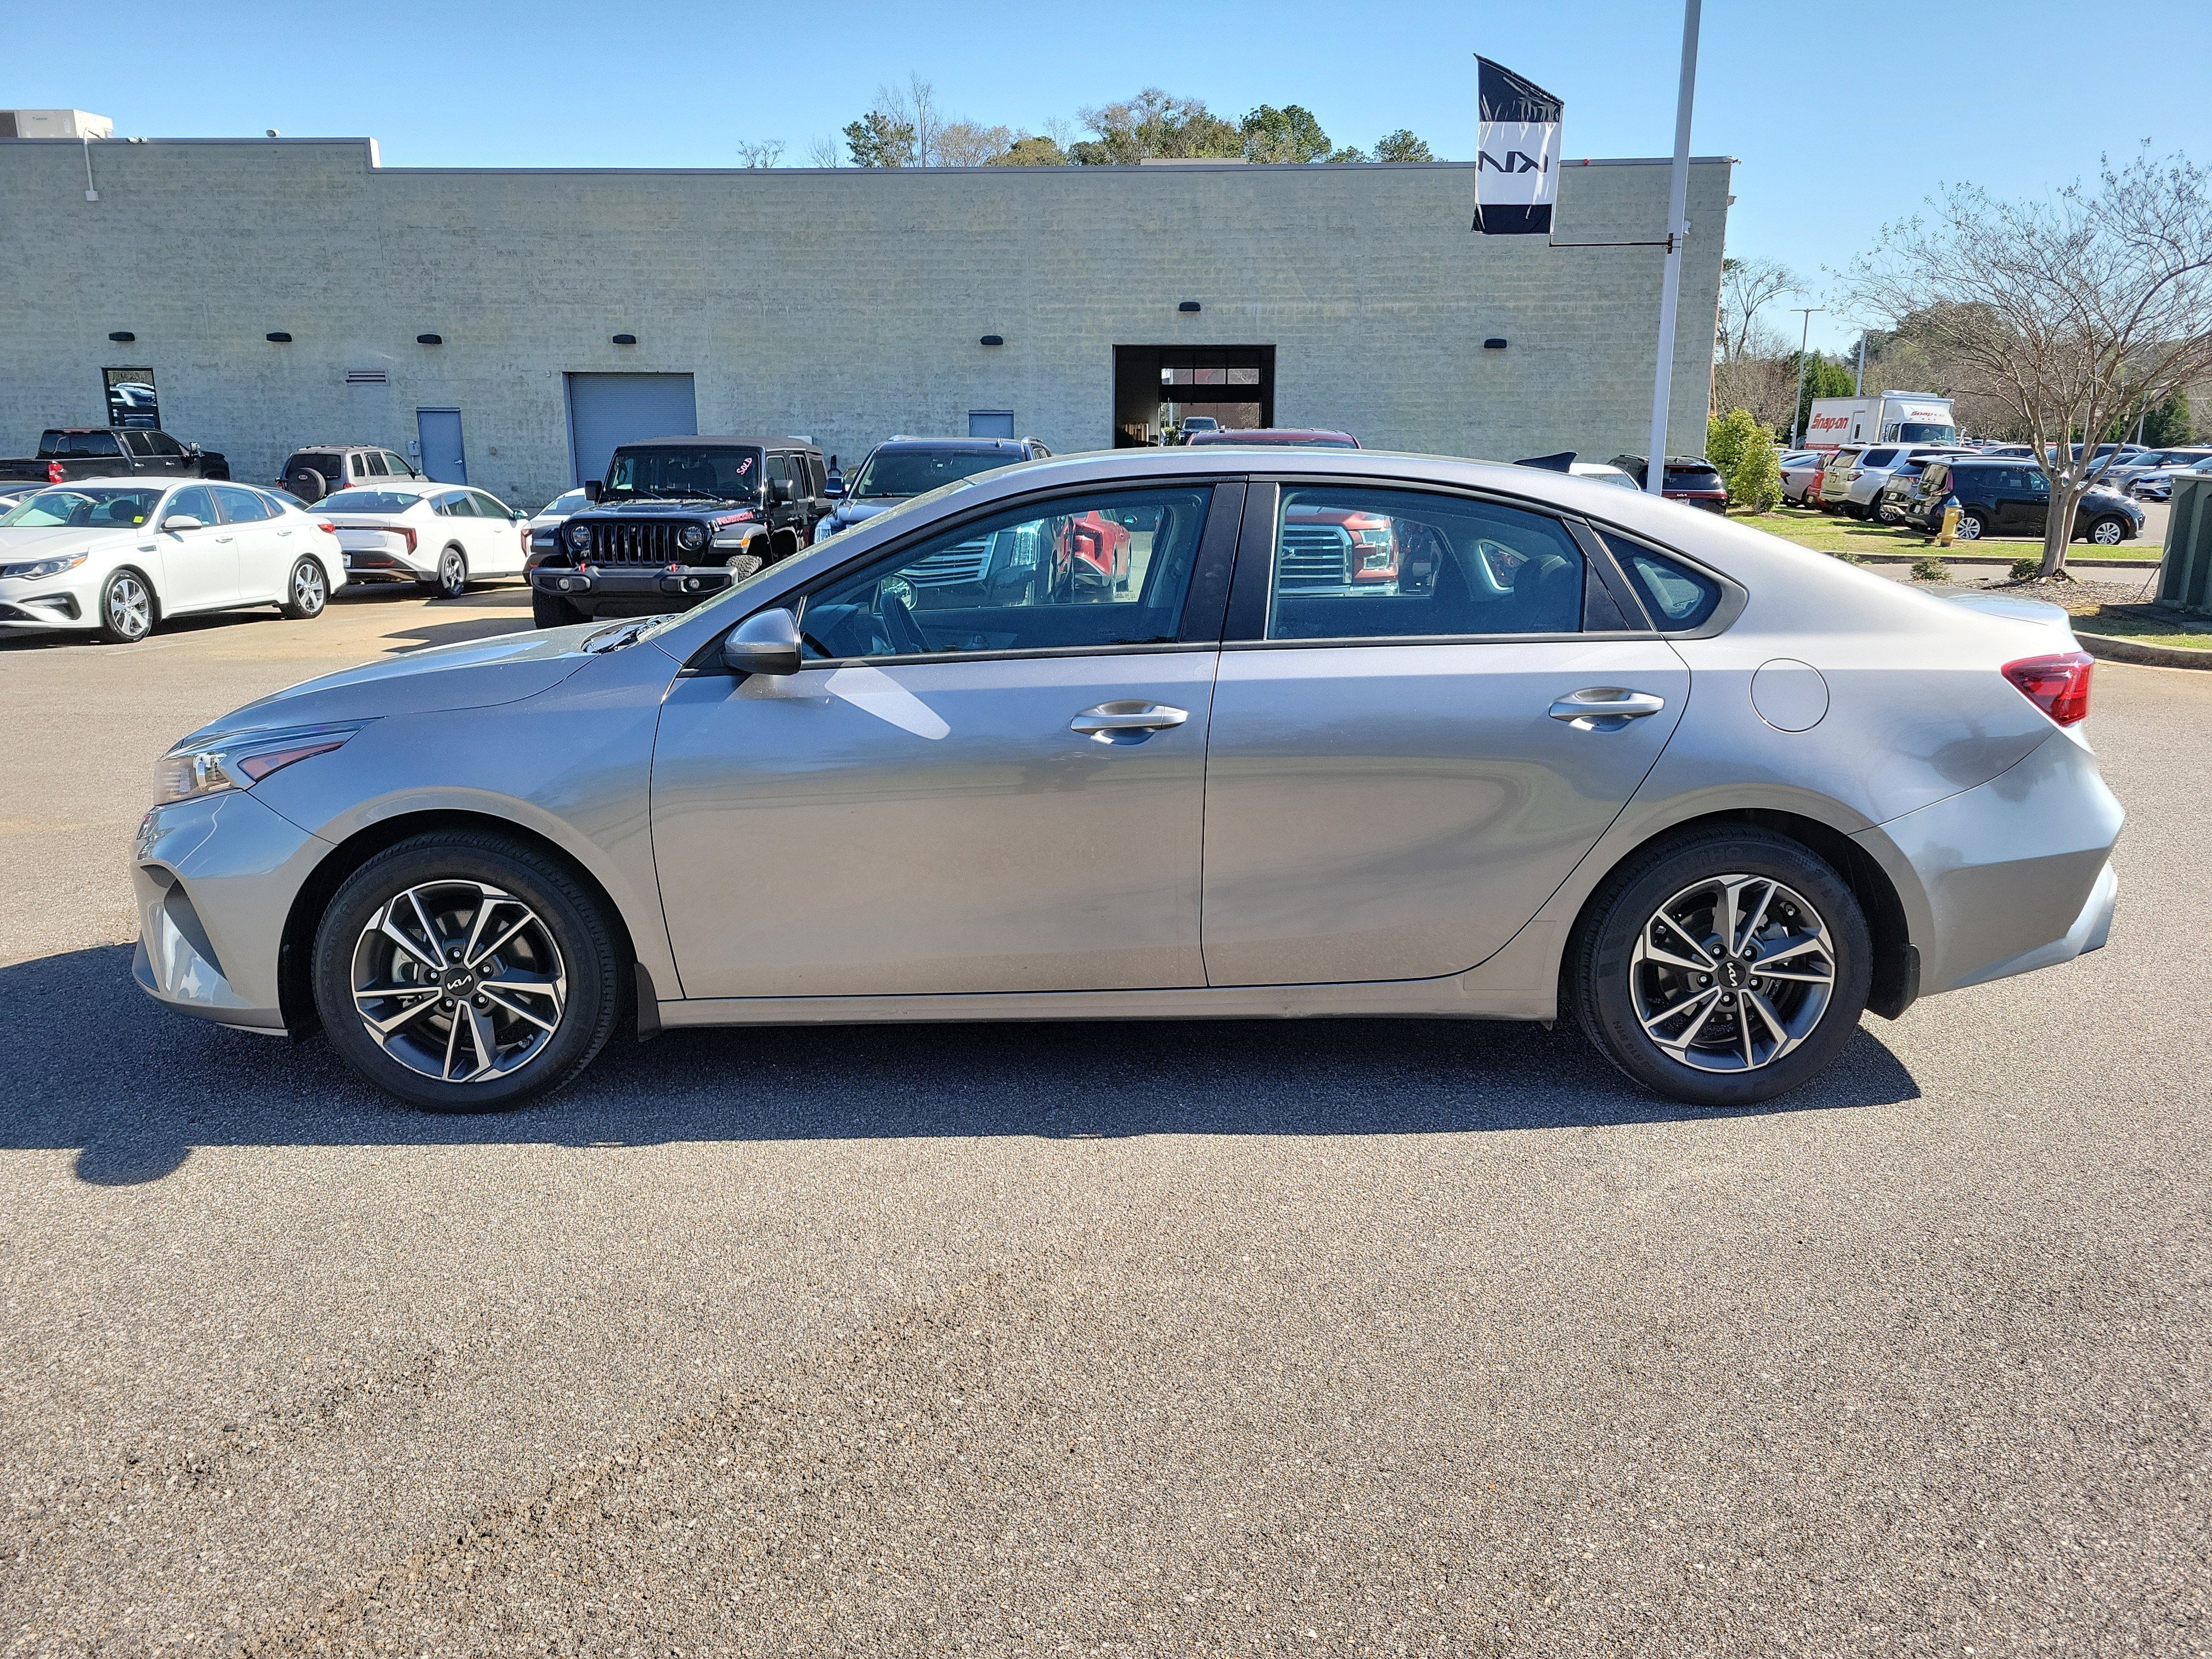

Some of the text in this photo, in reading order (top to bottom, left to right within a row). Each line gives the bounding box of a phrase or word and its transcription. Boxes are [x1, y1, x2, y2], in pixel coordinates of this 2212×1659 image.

[1810, 413, 1849, 433] Snap-on
[736, 457, 753, 475] SOLD
[447, 975, 472, 990] KIA
